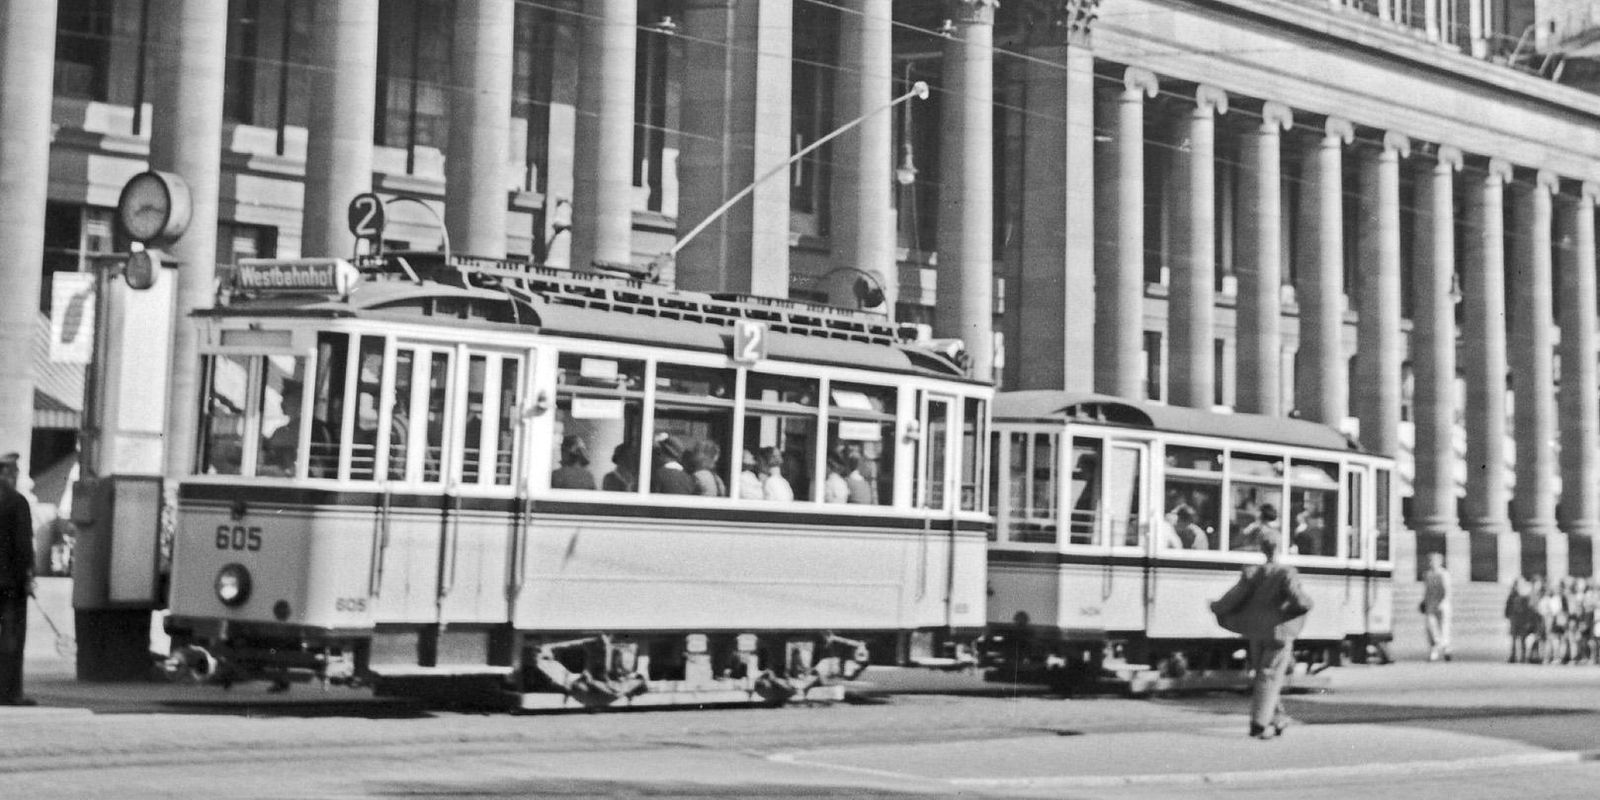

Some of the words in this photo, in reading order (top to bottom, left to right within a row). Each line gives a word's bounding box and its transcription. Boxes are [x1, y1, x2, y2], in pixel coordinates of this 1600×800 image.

[355, 197, 377, 235] 2
[241, 265, 333, 287] Westbahnhof
[743, 322, 761, 359] 2
[216, 525, 262, 551] 605
[336, 597, 367, 612] 605
